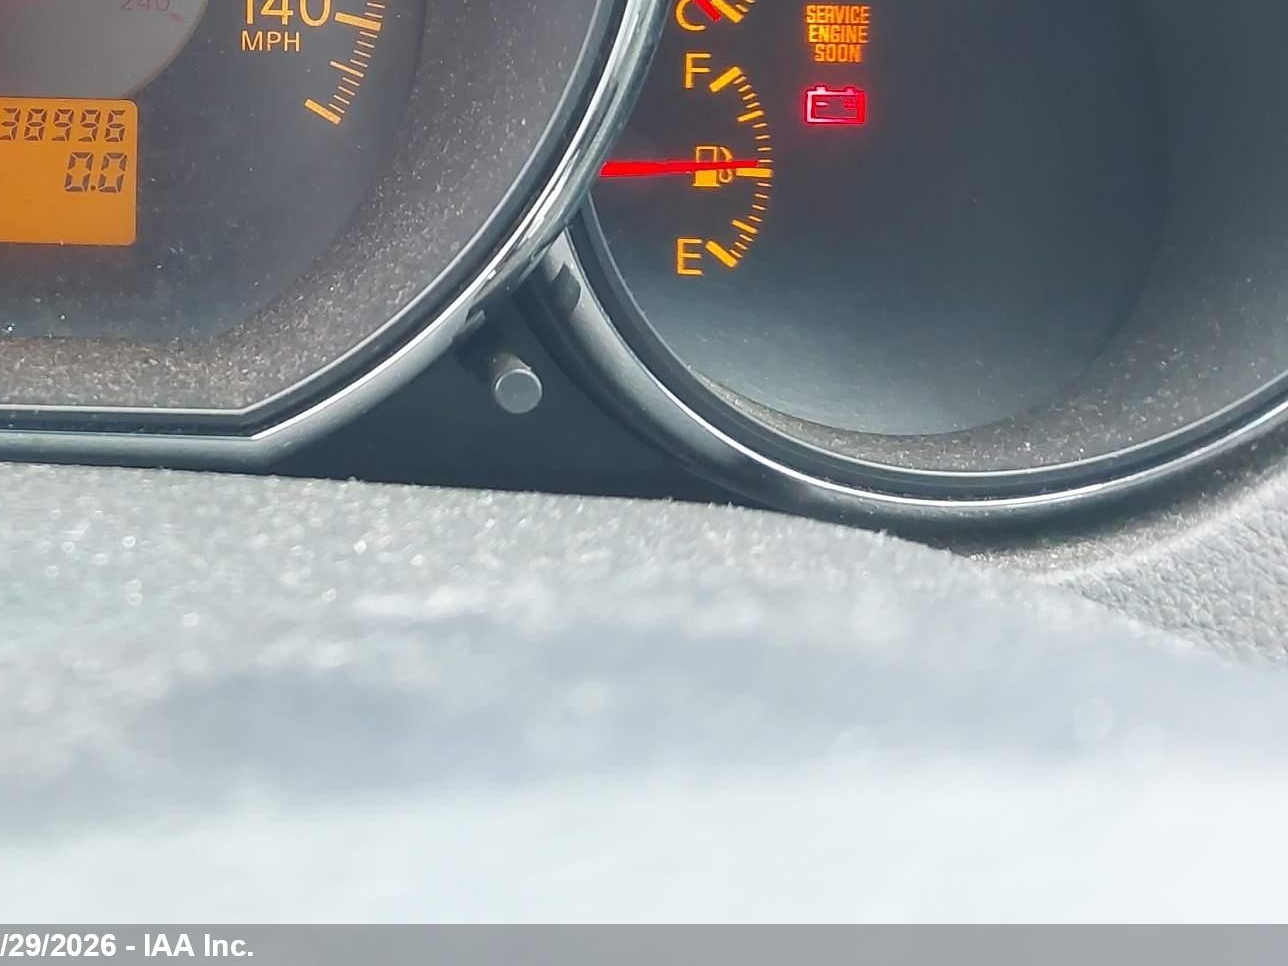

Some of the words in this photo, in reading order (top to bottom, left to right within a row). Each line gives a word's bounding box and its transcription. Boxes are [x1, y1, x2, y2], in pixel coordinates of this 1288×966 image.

[806, 5, 871, 25] SERVICE
[240, 30, 301, 53] MPH
[808, 26, 868, 44] ENGINE
[815, 45, 862, 63] SOON
[685, 53, 711, 90] F
[64, 151, 127, 193] 0.0
[676, 238, 703, 276] E
